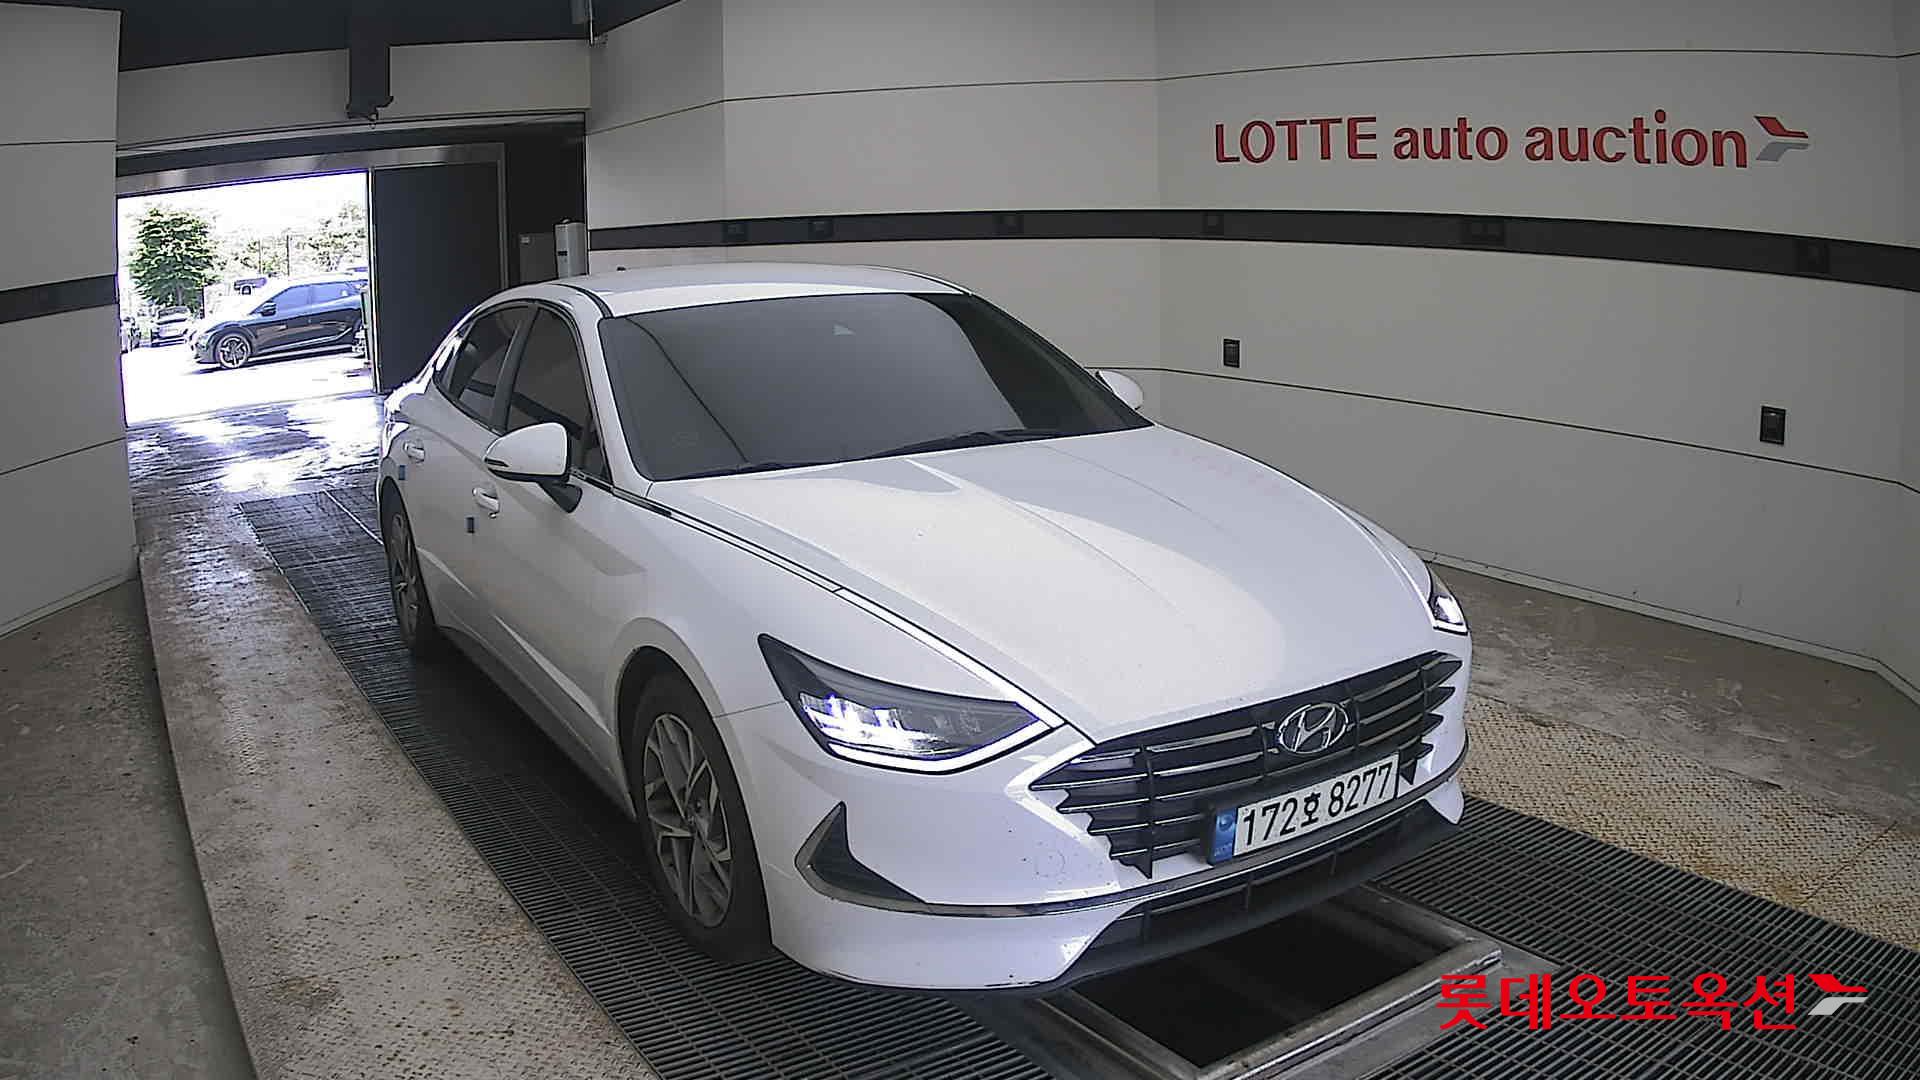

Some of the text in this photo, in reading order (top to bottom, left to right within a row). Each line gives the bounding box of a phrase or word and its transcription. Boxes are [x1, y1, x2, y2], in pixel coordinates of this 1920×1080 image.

[1215, 110, 1747, 168] LOTTE auto auction
[1243, 763, 1393, 845] 172호 8277
